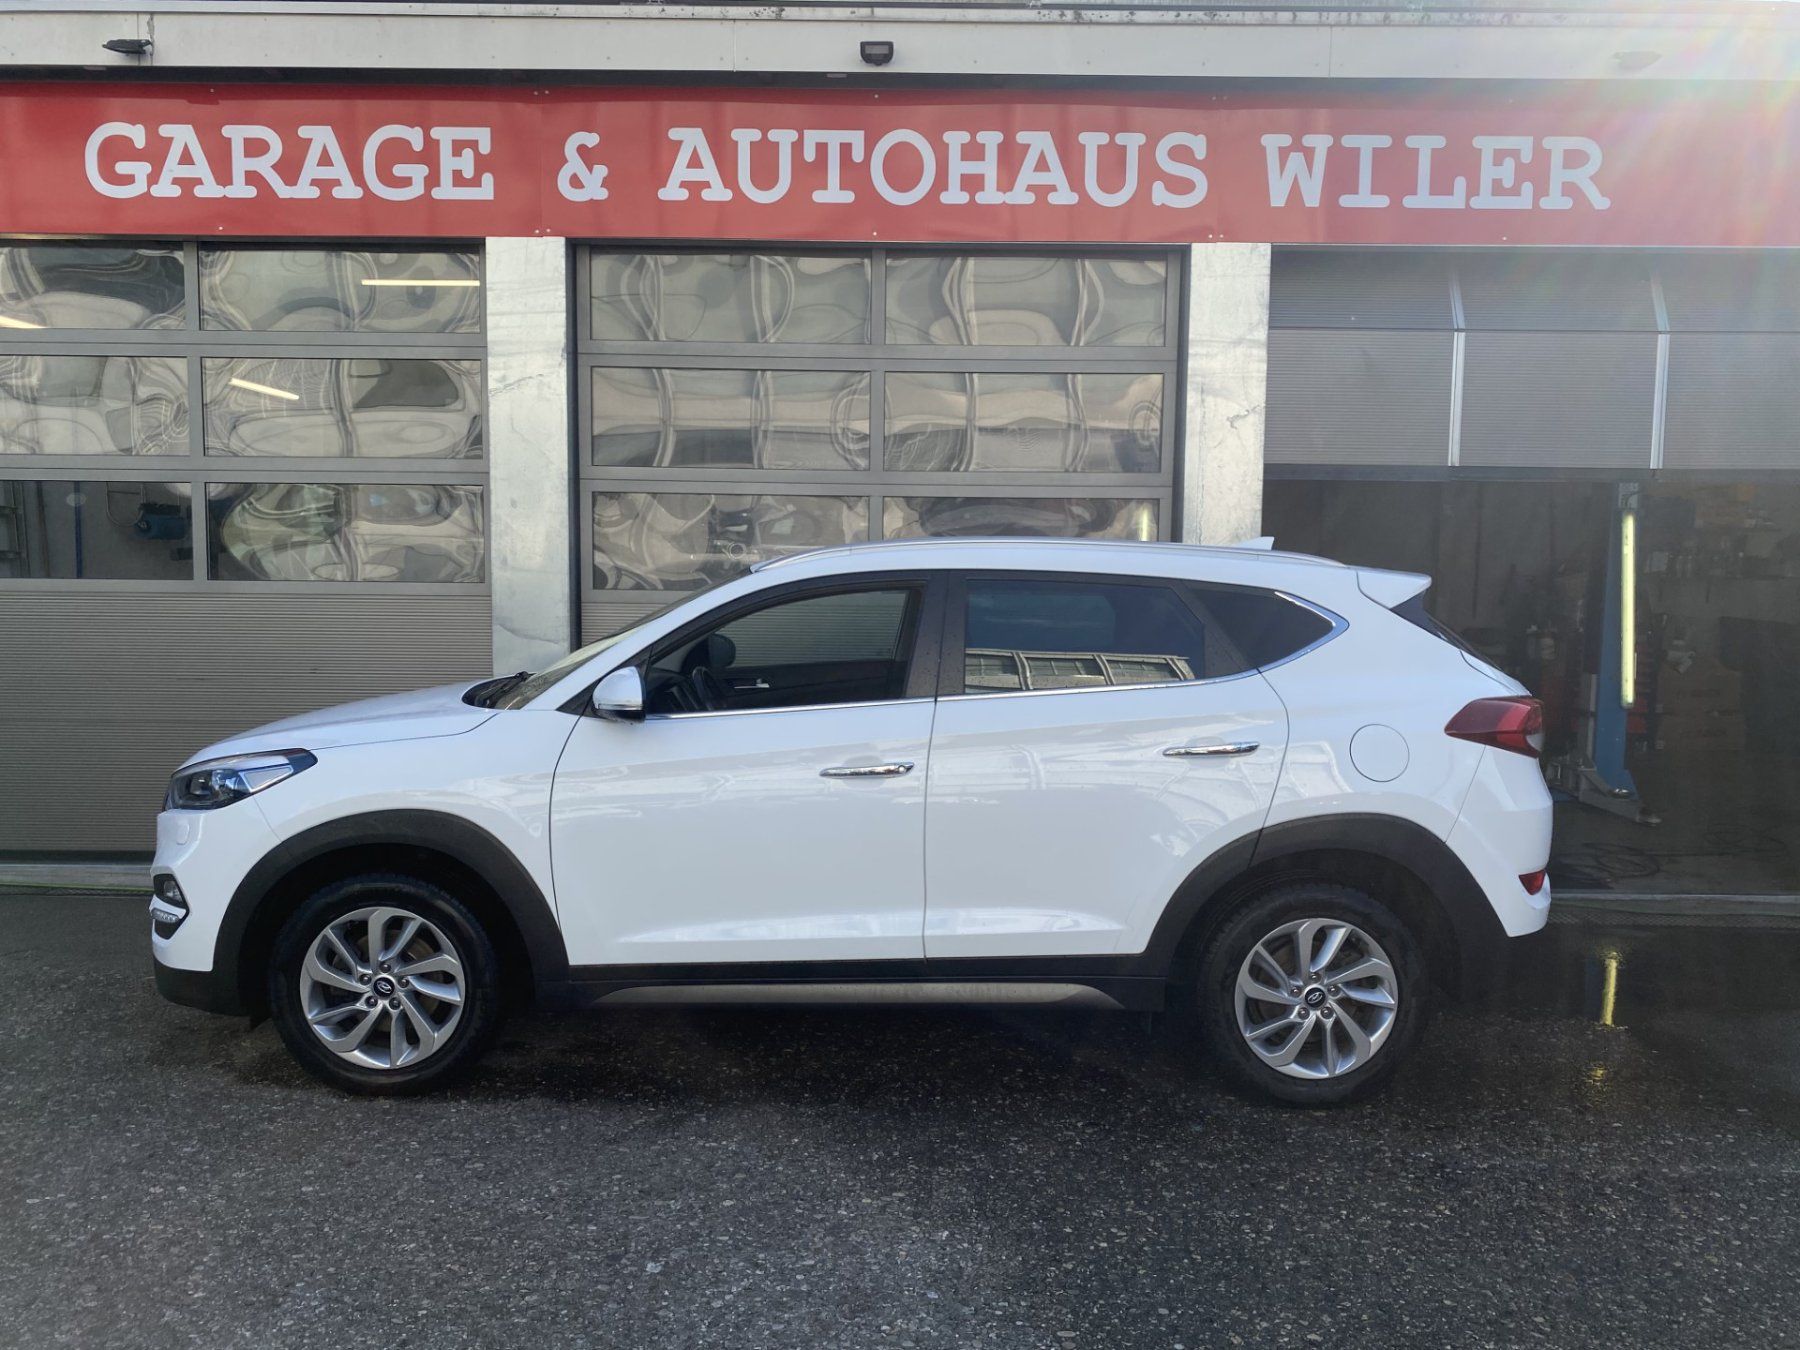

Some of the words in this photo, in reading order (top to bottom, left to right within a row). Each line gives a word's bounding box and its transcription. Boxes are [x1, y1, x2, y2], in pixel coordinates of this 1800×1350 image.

[85, 122, 494, 200] GARAGE
[557, 132, 609, 201] &
[658, 128, 1208, 208] AUTOHAUS
[1261, 133, 1612, 211] WILER
